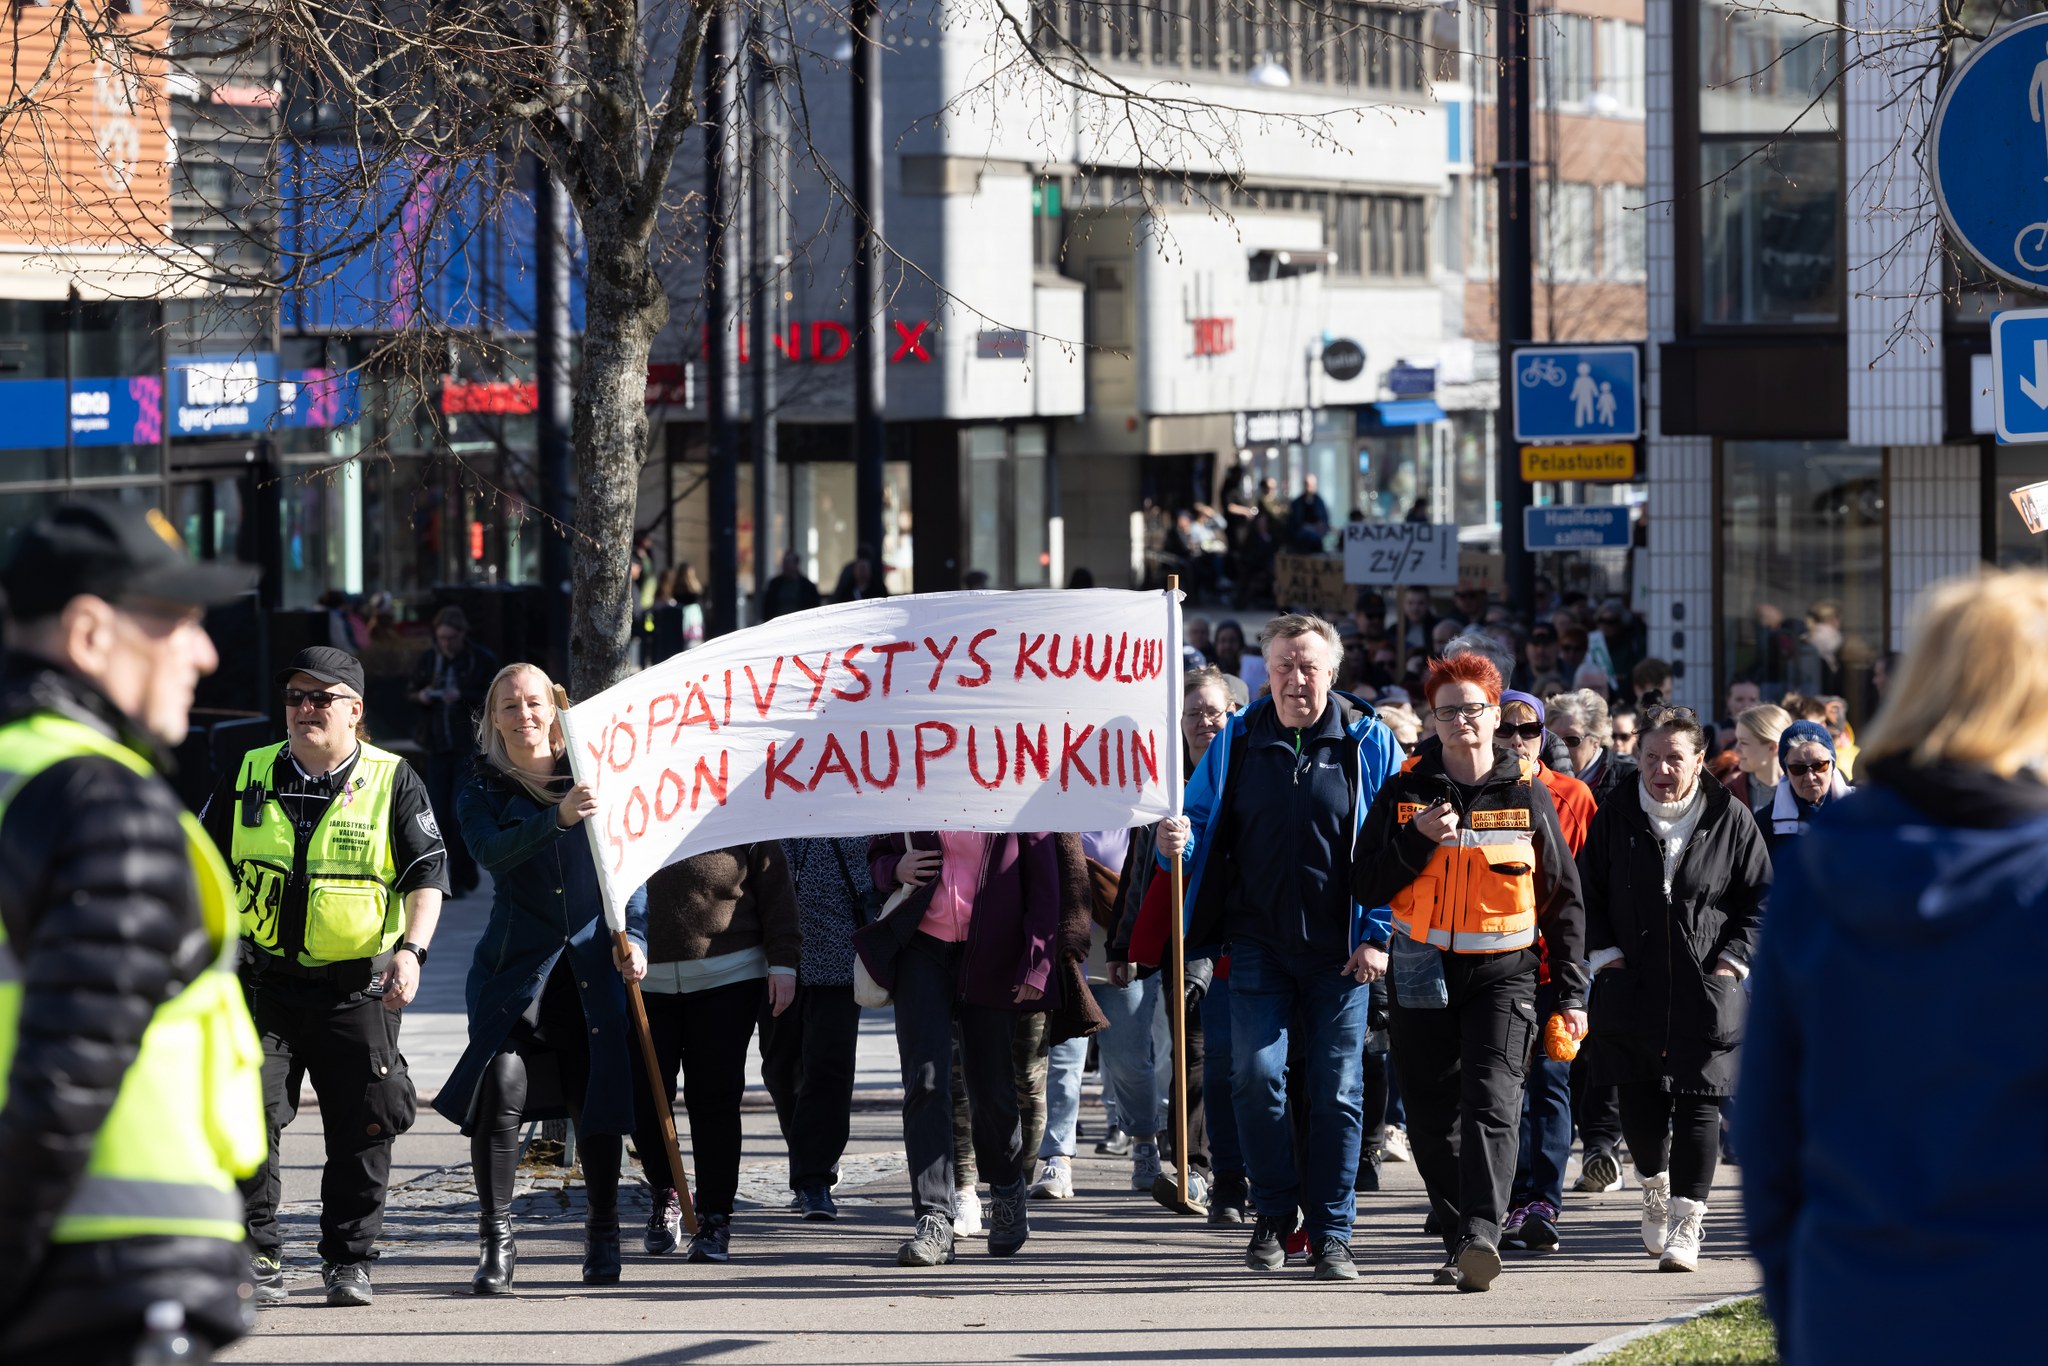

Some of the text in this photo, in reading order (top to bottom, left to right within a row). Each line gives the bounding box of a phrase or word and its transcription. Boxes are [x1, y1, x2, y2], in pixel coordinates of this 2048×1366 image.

[1529, 450, 1626, 472] Pelastustie
[588, 629, 997, 791] YÖPÄIVYSTYS
[765, 720, 1160, 801] KAUPUNKIIN
[339, 829, 365, 838] VALVOJA
